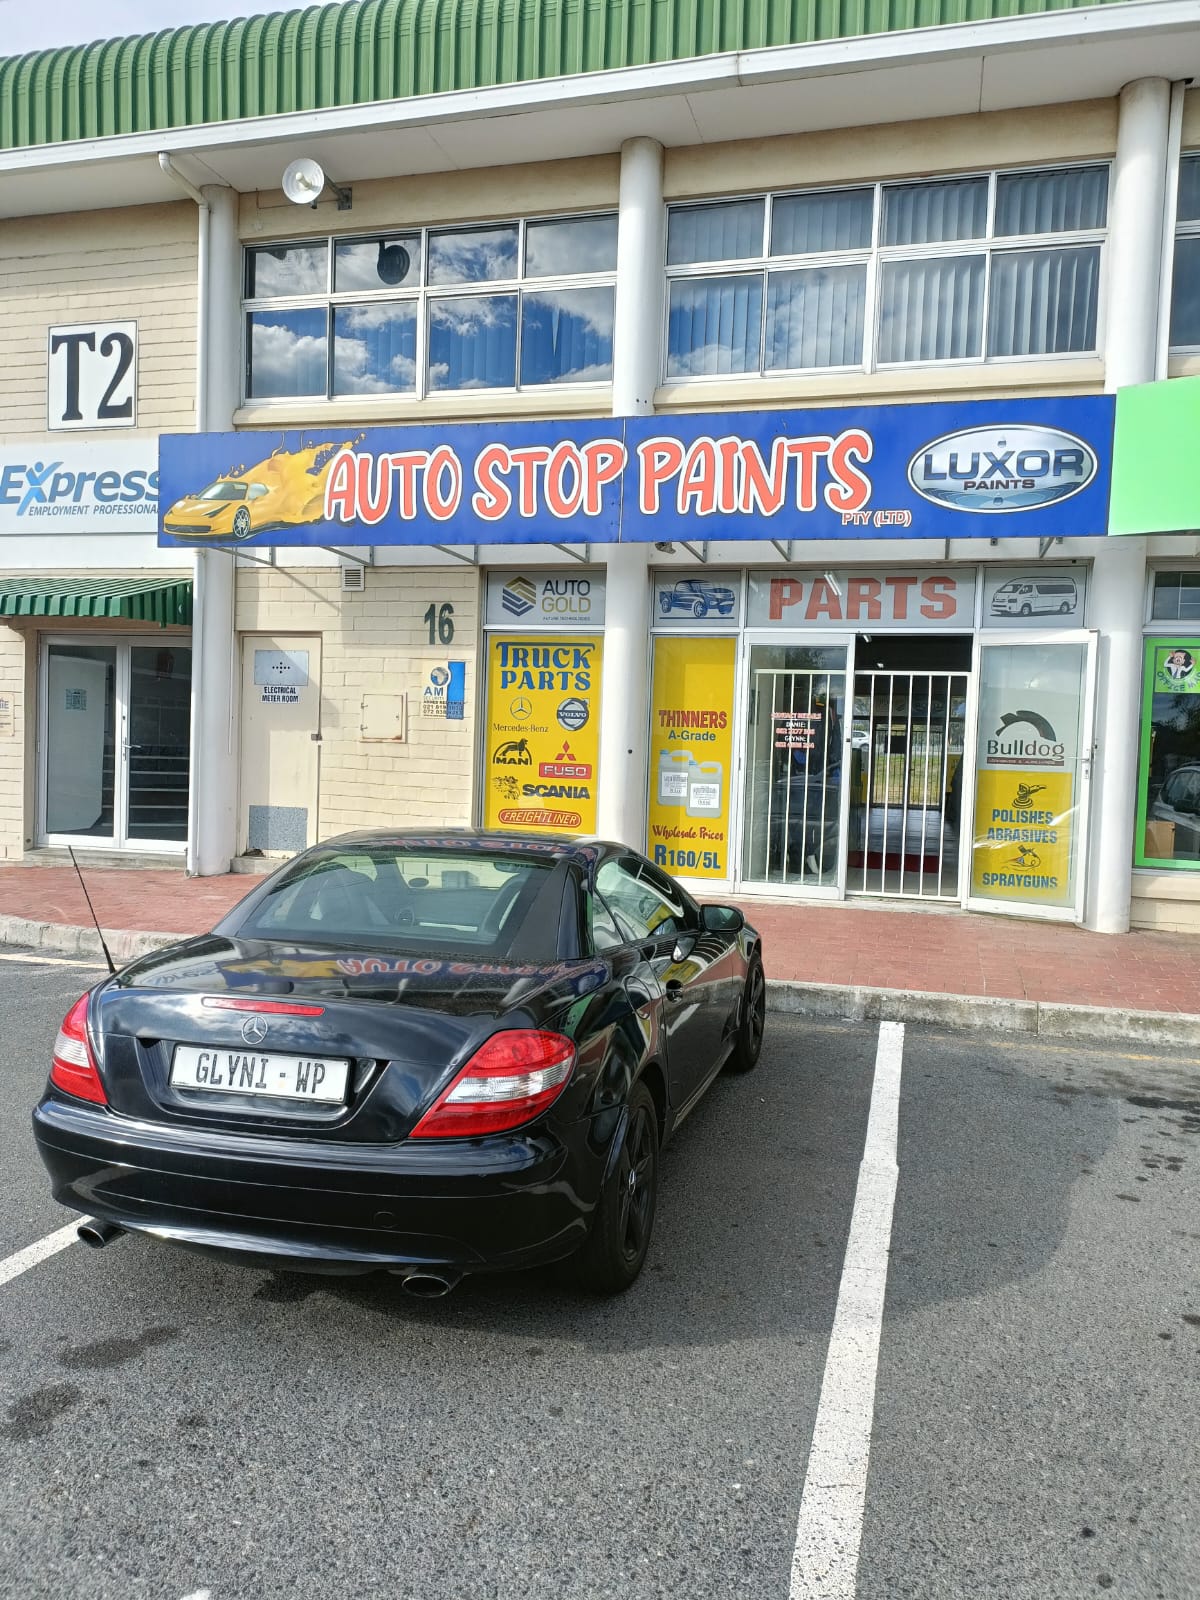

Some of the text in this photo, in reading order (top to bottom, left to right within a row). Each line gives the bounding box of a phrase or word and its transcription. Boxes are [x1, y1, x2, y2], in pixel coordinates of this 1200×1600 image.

[51, 332, 136, 421] T2
[923, 448, 1084, 481] LUXOR
[324, 428, 873, 524] AUTO STOP PAINTS
[963, 479, 1035, 490] PAINTS
[28, 503, 158, 517] EMPLOYMENT PROFESSIONA
[841, 509, 912, 528] PTY (LTD)
[542, 579, 591, 596] AUTO
[541, 597, 592, 613] GOLD
[769, 576, 957, 620] PARTS
[424, 603, 455, 645] 16
[496, 641, 596, 669] TRUCK
[500, 670, 591, 691] PARTS
[261, 694, 299, 703] METER ROOM
[264, 686, 297, 695] ELECTRICAL
[424, 686, 444, 697] AM
[558, 710, 587, 718] VOLVO
[658, 710, 728, 729] THINNERS
[492, 723, 549, 733] Mercedes-Benz
[668, 729, 717, 741] A-Grade
[987, 739, 1065, 761] Bulldog
[495, 757, 529, 766] MAN
[544, 765, 587, 776] FUSO
[522, 783, 590, 799] SCANIA
[503, 811, 577, 825] FREIGHTLINER
[991, 808, 1054, 825] POLISHES
[652, 824, 724, 841] Wholesale Prices
[987, 827, 1058, 844] ABRASIVES
[654, 844, 721, 869] R160/5L
[982, 872, 1058, 889] SPRAYGUNS
[195, 1053, 269, 1089] GLYNI
[295, 1061, 326, 1094] WP
